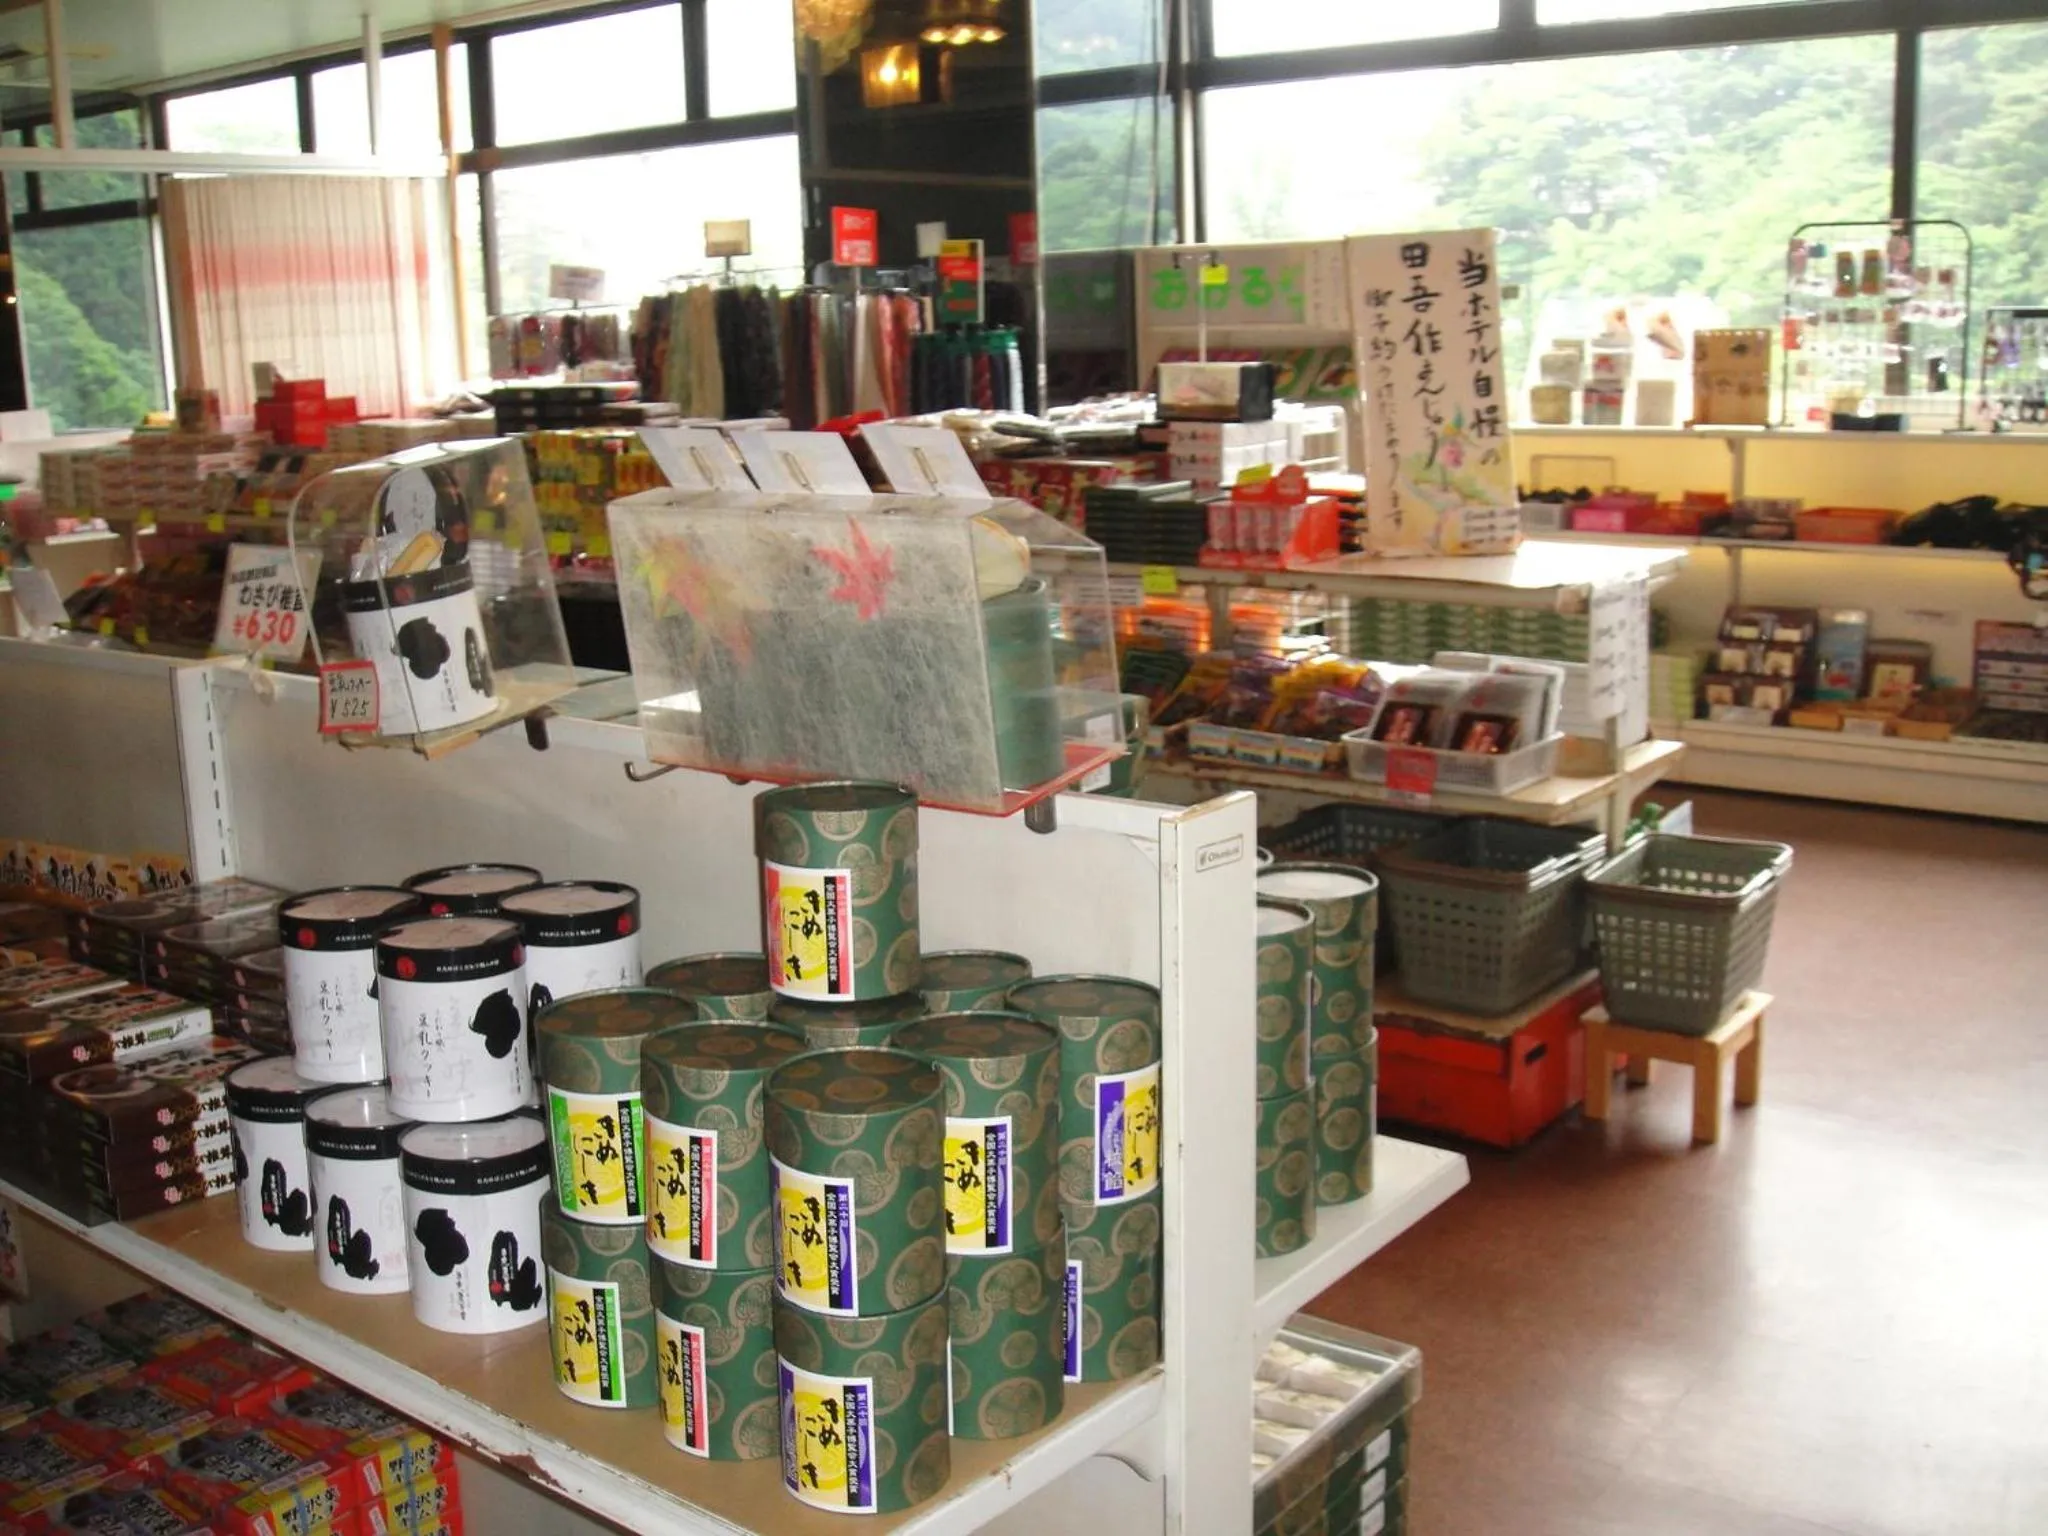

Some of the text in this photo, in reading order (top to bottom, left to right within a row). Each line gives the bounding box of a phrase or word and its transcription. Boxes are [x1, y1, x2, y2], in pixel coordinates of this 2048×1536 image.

[1456, 247, 1506, 466] 当ホテル自慢の
[232, 608, 297, 645] ¥630
[329, 696, 371, 720] ¥525
